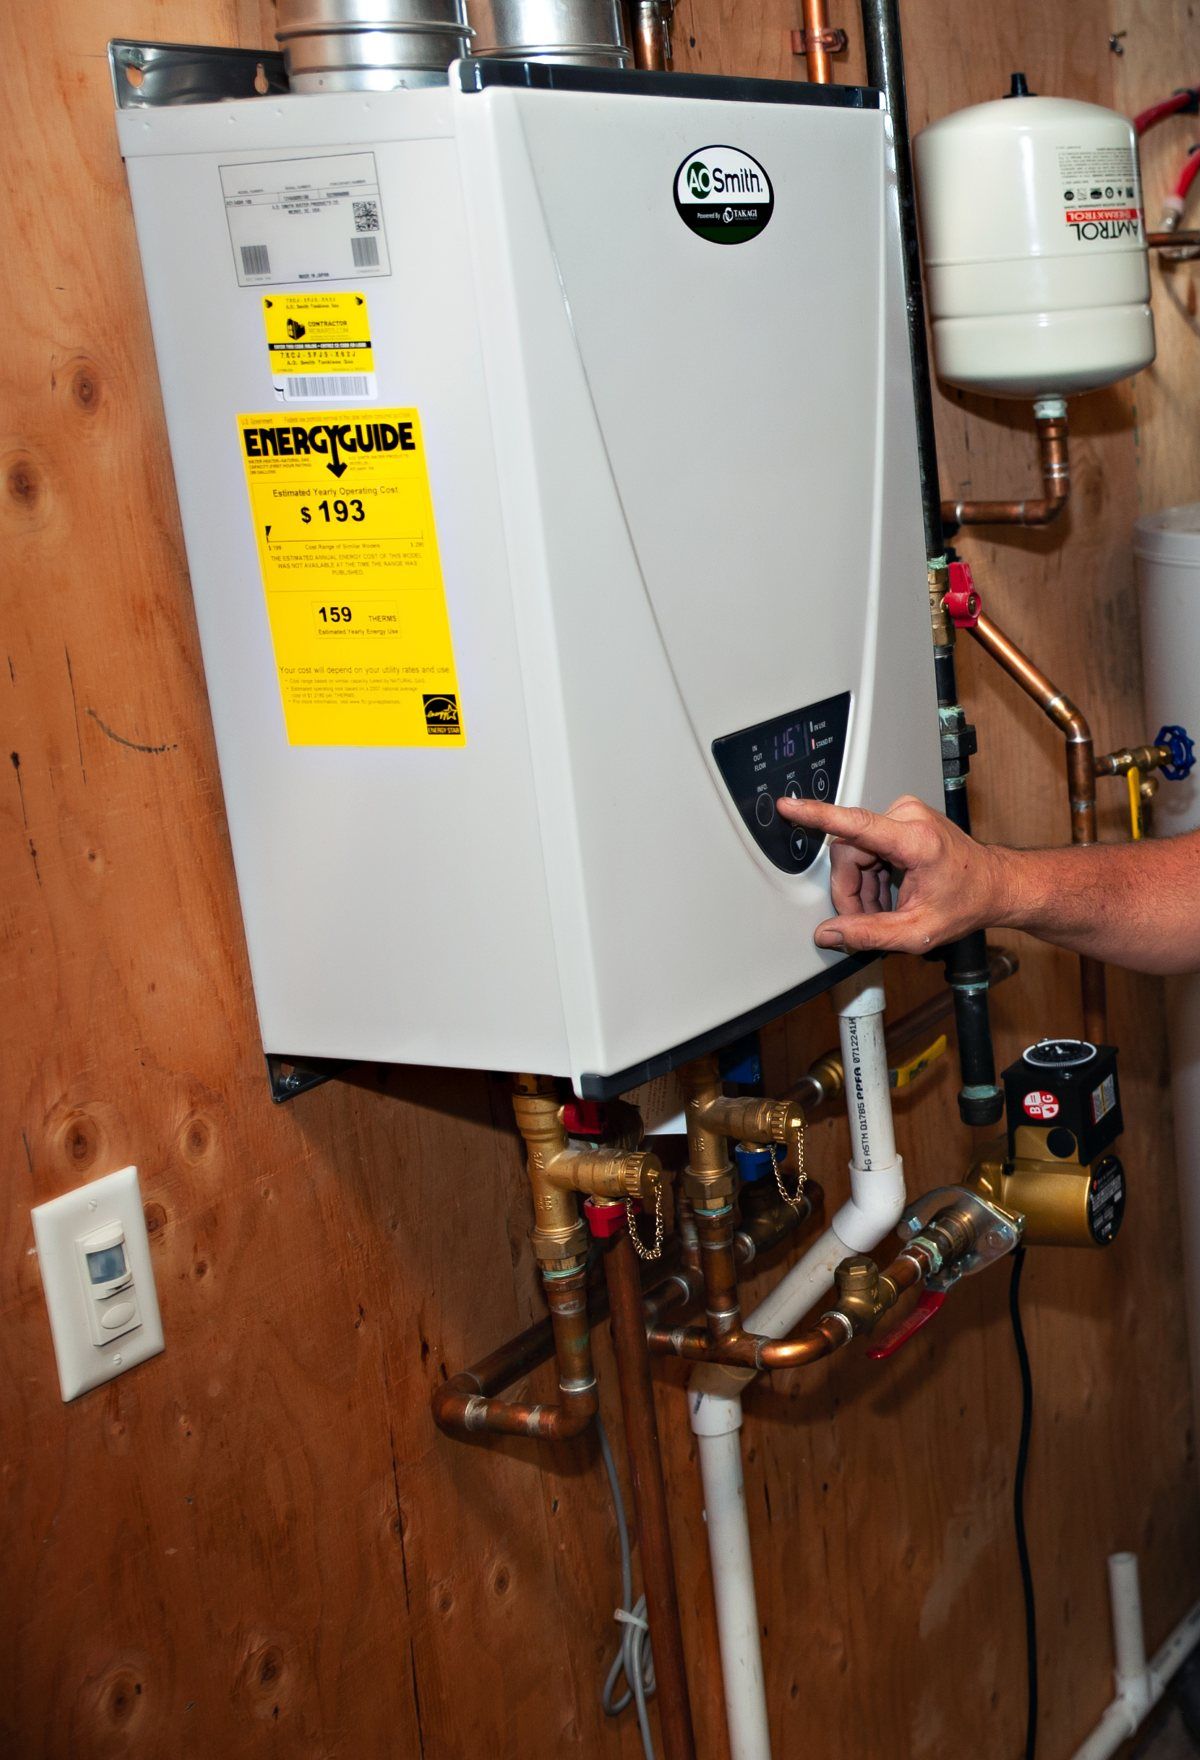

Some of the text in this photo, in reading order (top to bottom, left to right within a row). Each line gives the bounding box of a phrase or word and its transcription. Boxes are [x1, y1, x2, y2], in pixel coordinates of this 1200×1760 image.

[733, 209, 758, 218] TAKAGI
[1068, 221, 1139, 241] AMTROL
[243, 422, 416, 459] ENERGYGUIDE
[273, 486, 399, 498] Estimated Yearly Operating Cost
[300, 499, 366, 524] $ 193
[318, 606, 398, 623] 159 THERMS
[279, 666, 296, 674] Your
[297, 666, 313, 674] cost
[326, 666, 353, 675] depend
[365, 667, 380, 676] your
[381, 665, 400, 676] utility
[402, 666, 420, 674] rates
[753, 752, 763, 762] OUT
[754, 762, 766, 772] FLOW
[786, 771, 795, 780] HOT
[853, 1066, 863, 1100] PPFA
[857, 1102, 867, 1131] D1785
[861, 1132, 871, 1157] ASTM
